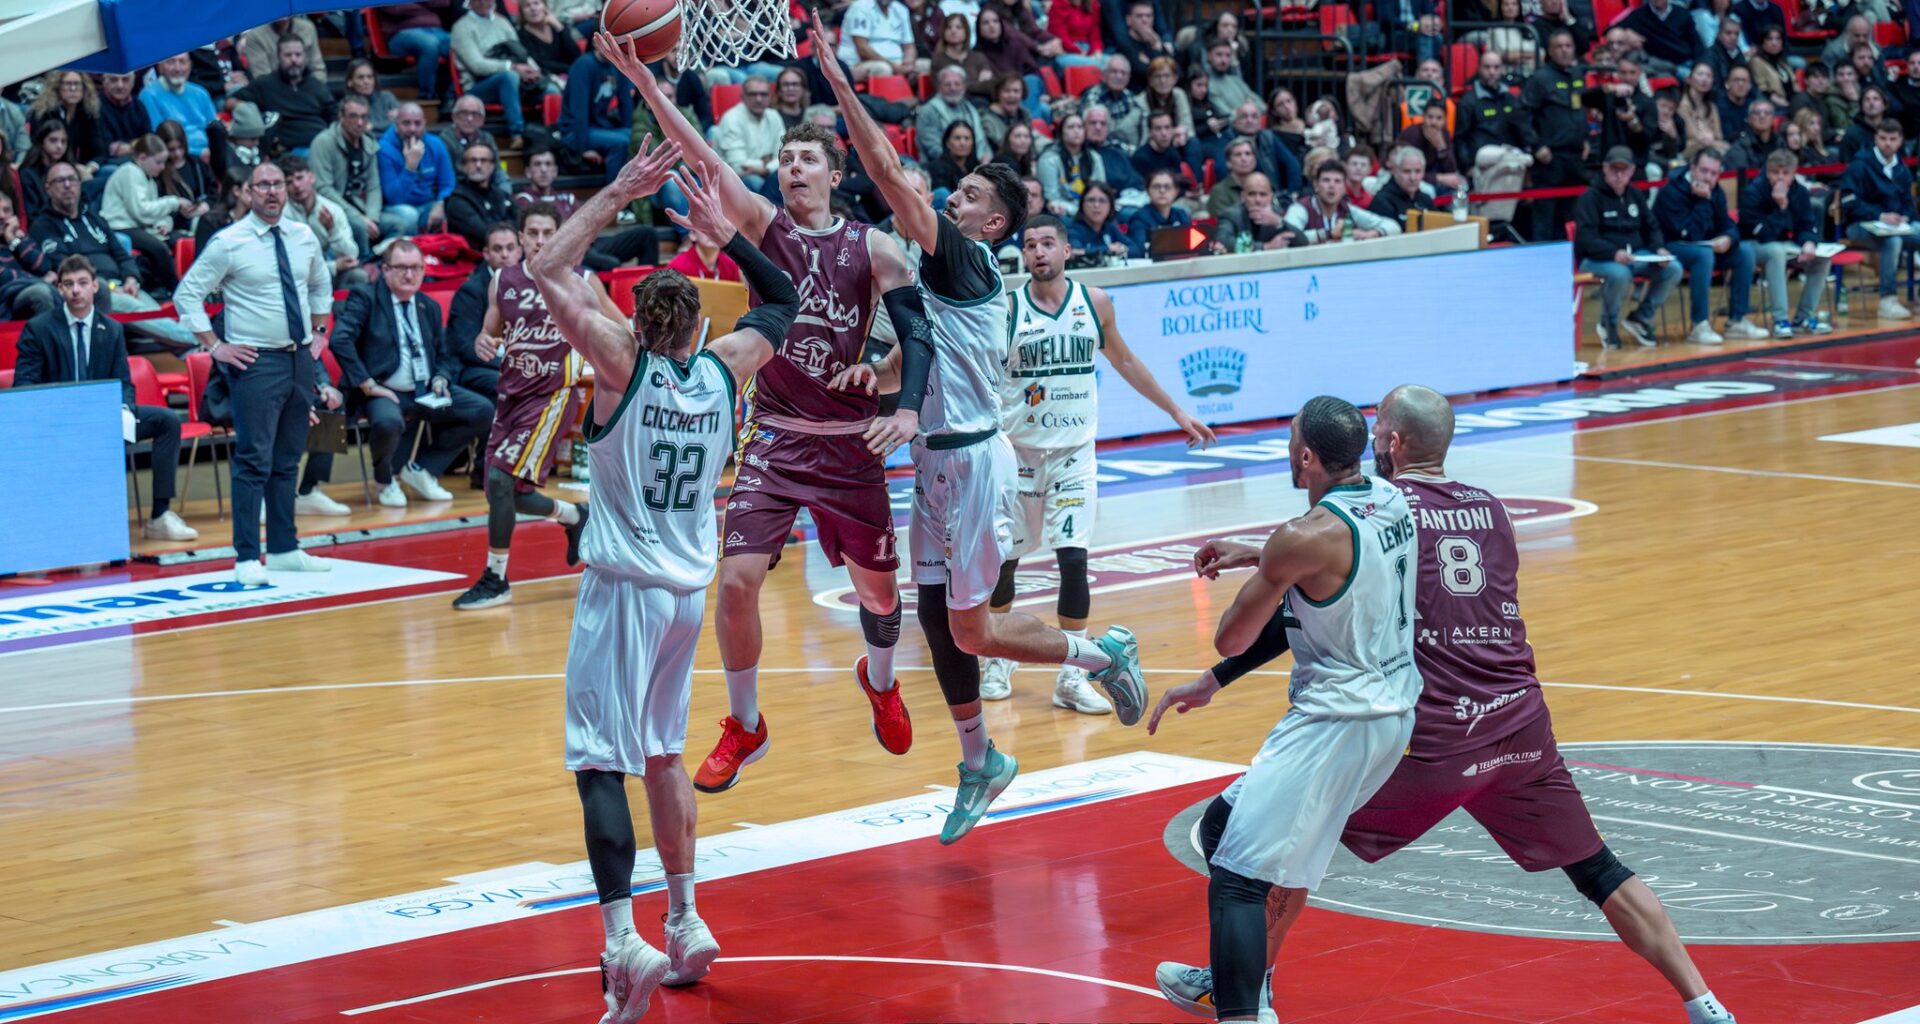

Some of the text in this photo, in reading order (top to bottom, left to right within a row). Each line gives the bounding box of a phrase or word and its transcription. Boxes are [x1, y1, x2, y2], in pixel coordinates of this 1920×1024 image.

[518, 289, 547, 310] 24
[1164, 280, 1260, 311] ACQUA DI
[1023, 311, 1032, 325] 4
[1161, 307, 1270, 337] BOLGHERI
[1018, 334, 1095, 369] AVELLINO
[642, 404, 720, 434] CICCHETTI
[1196, 402, 1234, 415] TOSCANA
[1454, 380, 1777, 431] VORNO
[494, 439, 521, 464] 24
[642, 439, 708, 513] 32
[1061, 514, 1073, 539] 4
[1377, 514, 1415, 555] LEWIS
[1435, 534, 1487, 597] 8
[1394, 553, 1409, 631] 1
[1452, 626, 1512, 638] AKERN
[1751, 807, 1883, 831] Ponsacco
